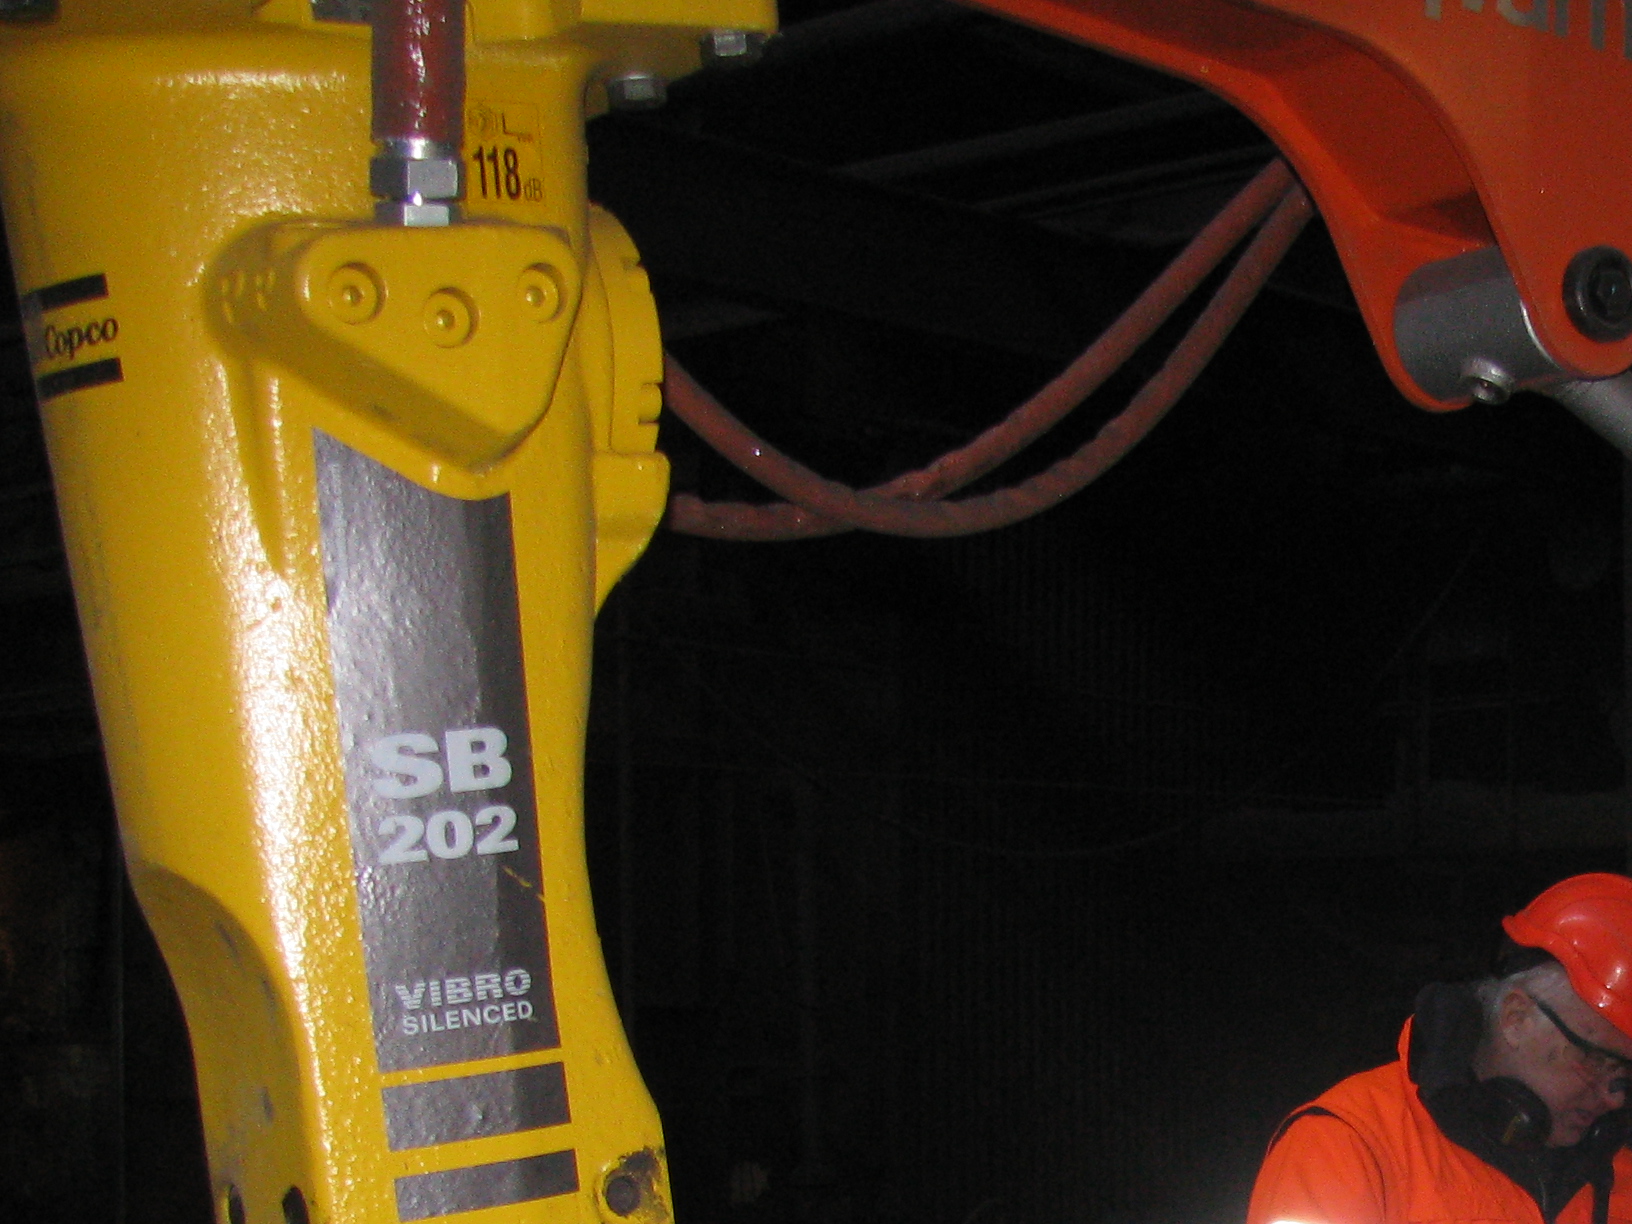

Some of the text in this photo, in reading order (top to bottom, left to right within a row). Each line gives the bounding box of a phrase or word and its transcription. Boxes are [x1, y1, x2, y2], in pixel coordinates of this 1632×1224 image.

[45, 317, 119, 360] Copco
[372, 727, 513, 800] SB
[377, 805, 520, 866] 202
[395, 968, 532, 1010] VIBRO
[402, 1000, 534, 1036] SILENCED
